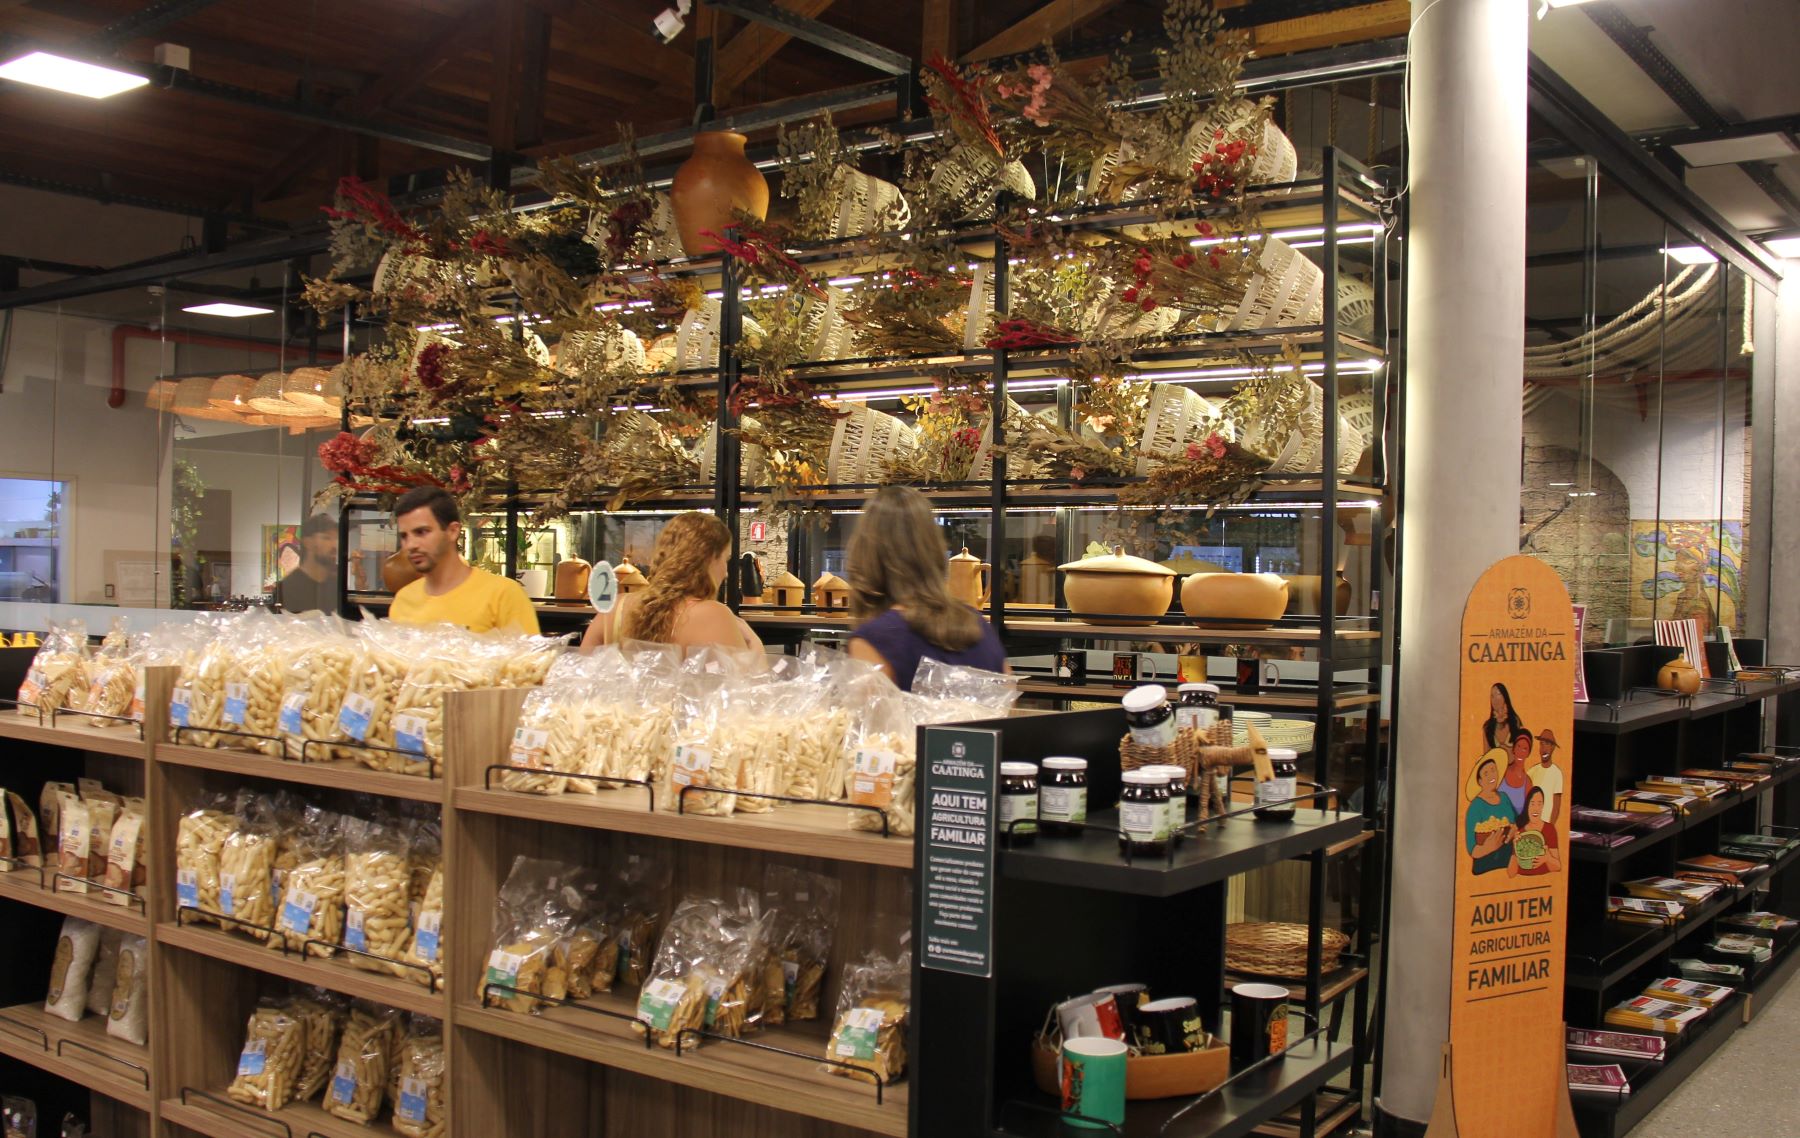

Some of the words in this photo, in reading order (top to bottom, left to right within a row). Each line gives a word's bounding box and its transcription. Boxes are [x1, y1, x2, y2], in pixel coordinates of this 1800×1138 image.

[597, 572, 611, 601] 2
[1489, 625, 1533, 639] ARMAZÉM
[1535, 628, 1548, 639] DA
[1468, 641, 1566, 663] CAATINGA
[931, 764, 985, 779] CAATINGA
[931, 793, 960, 808] AQUI
[961, 796, 987, 811] TEM
[931, 812, 986, 827] AGRICULTURA
[930, 828, 986, 846] FAMILIAR
[1471, 901, 1513, 926] AQUI
[1517, 895, 1552, 920] TEM
[1470, 930, 1551, 956] AGRICULTURA
[1468, 958, 1550, 991] FAMILIAR
